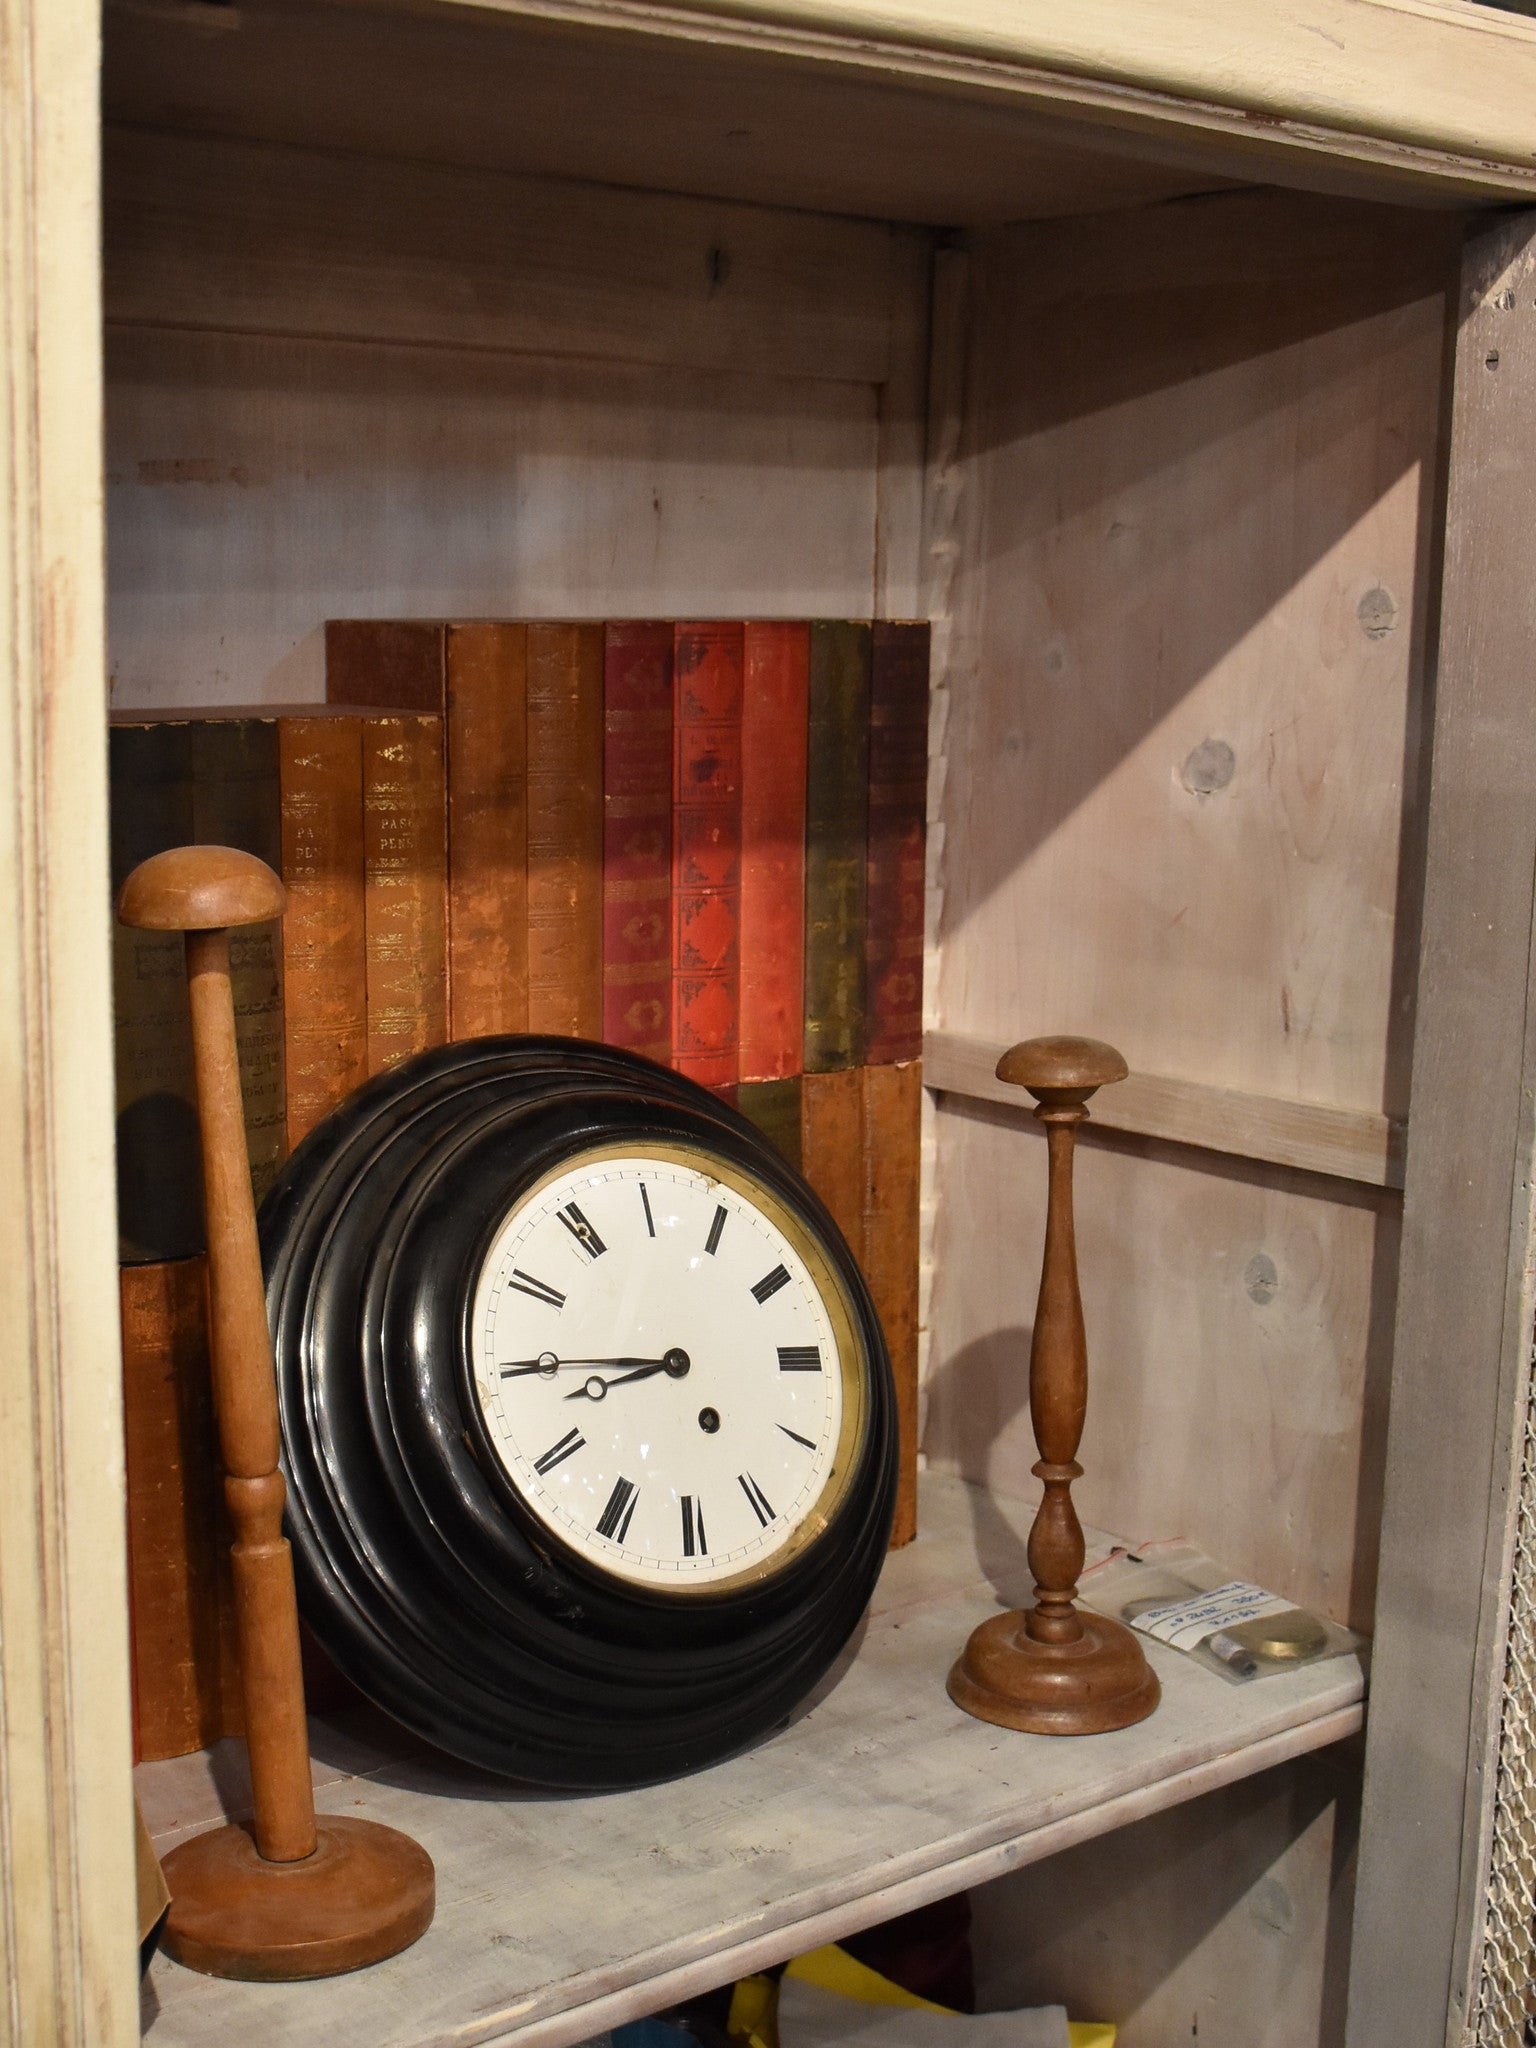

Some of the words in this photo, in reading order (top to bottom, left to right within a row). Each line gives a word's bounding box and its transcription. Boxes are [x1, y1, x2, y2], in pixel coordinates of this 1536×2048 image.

[703, 1204, 730, 1258] II
[507, 1268, 568, 1316] XI
[748, 1263, 792, 1308] III
[775, 1345, 823, 1372] IIII
[528, 1424, 588, 1477] IX
[594, 1474, 642, 1545] VIII
[677, 1494, 709, 1558] VII
[735, 1470, 777, 1529] VI
